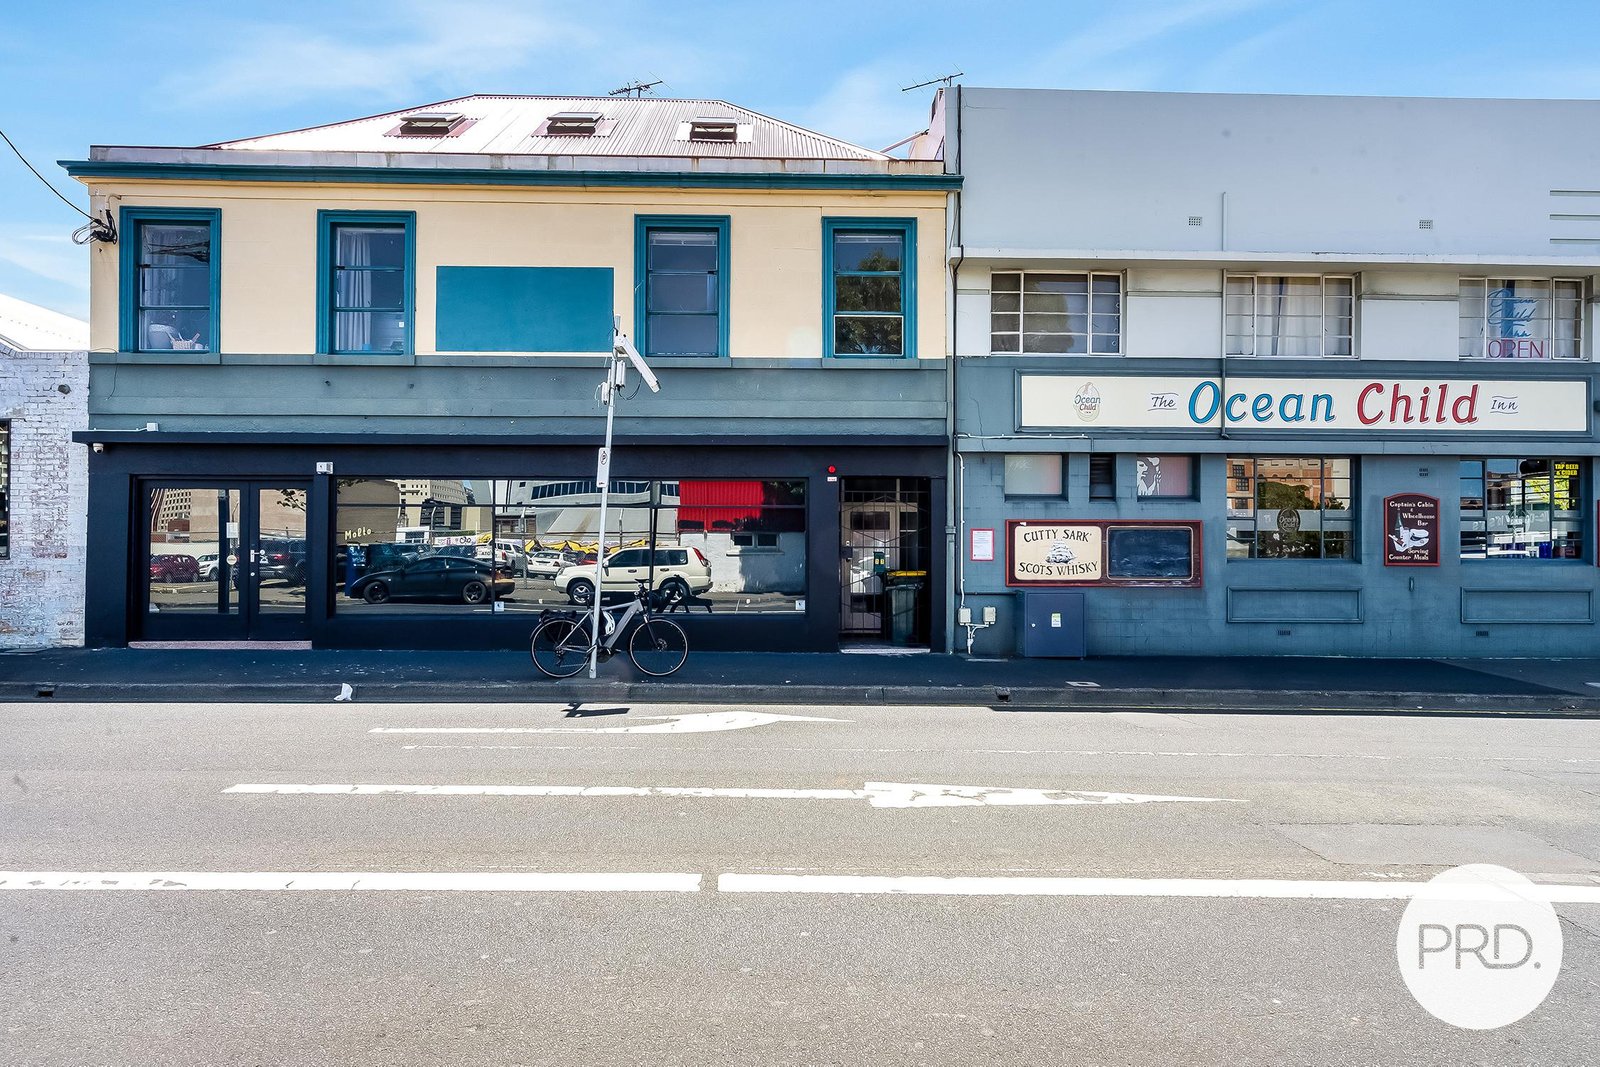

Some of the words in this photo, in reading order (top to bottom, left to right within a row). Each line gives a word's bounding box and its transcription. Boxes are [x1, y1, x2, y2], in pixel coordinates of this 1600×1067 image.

[1488, 339, 1544, 359] OPEN
[1074, 394, 1101, 405] Ocean
[1151, 396, 1176, 408] The
[1188, 380, 1335, 424] Ocean
[1357, 382, 1479, 425] Child
[1490, 399, 1519, 411] Inn
[1079, 403, 1097, 411] Child
[1402, 512, 1436, 520] Wheelhouse
[1024, 529, 1058, 543] CUTTY
[1062, 529, 1089, 543] SARK
[1388, 553, 1412, 561] Counter
[1407, 548, 1430, 556] Serving
[1018, 562, 1053, 576] SCOTS
[1057, 561, 1098, 576] WHISKY
